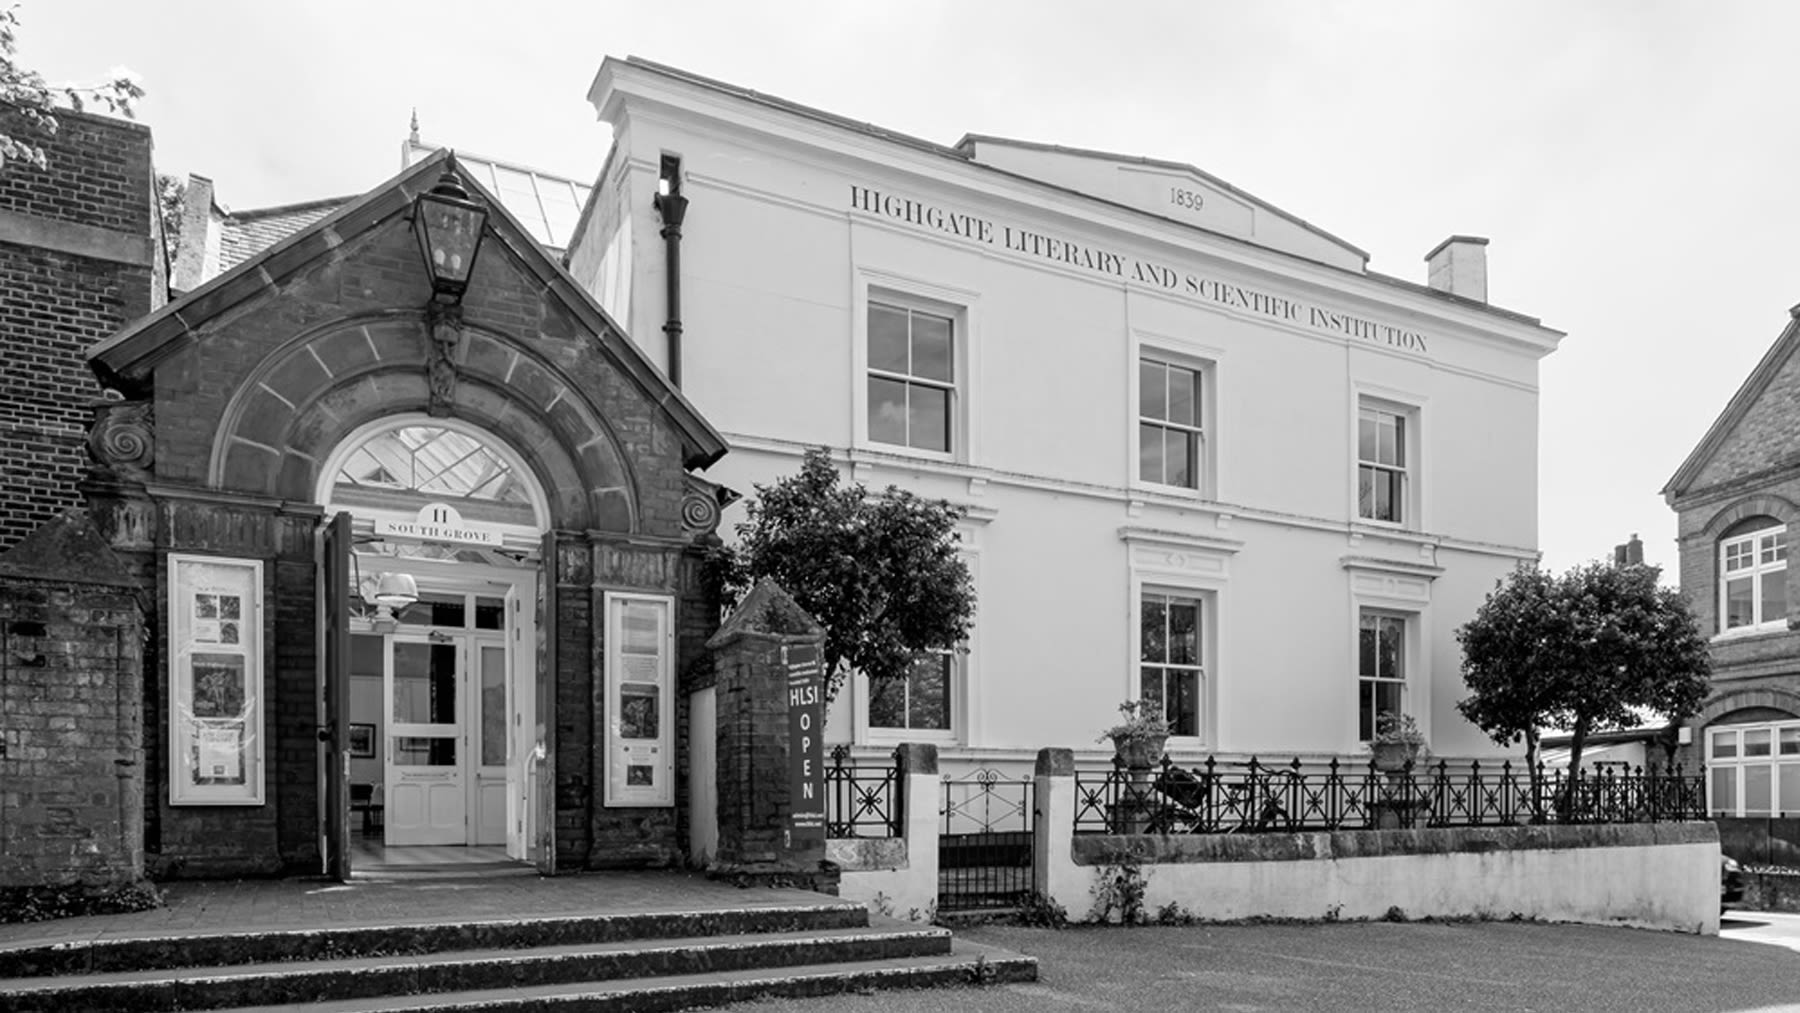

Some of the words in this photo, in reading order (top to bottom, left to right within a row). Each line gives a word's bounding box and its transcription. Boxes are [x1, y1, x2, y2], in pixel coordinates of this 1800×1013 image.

[1170, 187, 1204, 211] 1839
[850, 184, 993, 244] HIGHGATE
[1002, 226, 1126, 276] LITERARY
[1131, 261, 1178, 290] AND
[1185, 275, 1302, 321] SCIENTIFIC
[1309, 306, 1428, 352] INSTITUTION
[433, 508, 447, 524] 11
[388, 523, 439, 537] SOUTH
[443, 528, 490, 542] GROVE
[789, 685, 818, 706] HLSI
[799, 712, 813, 799] OPEN
